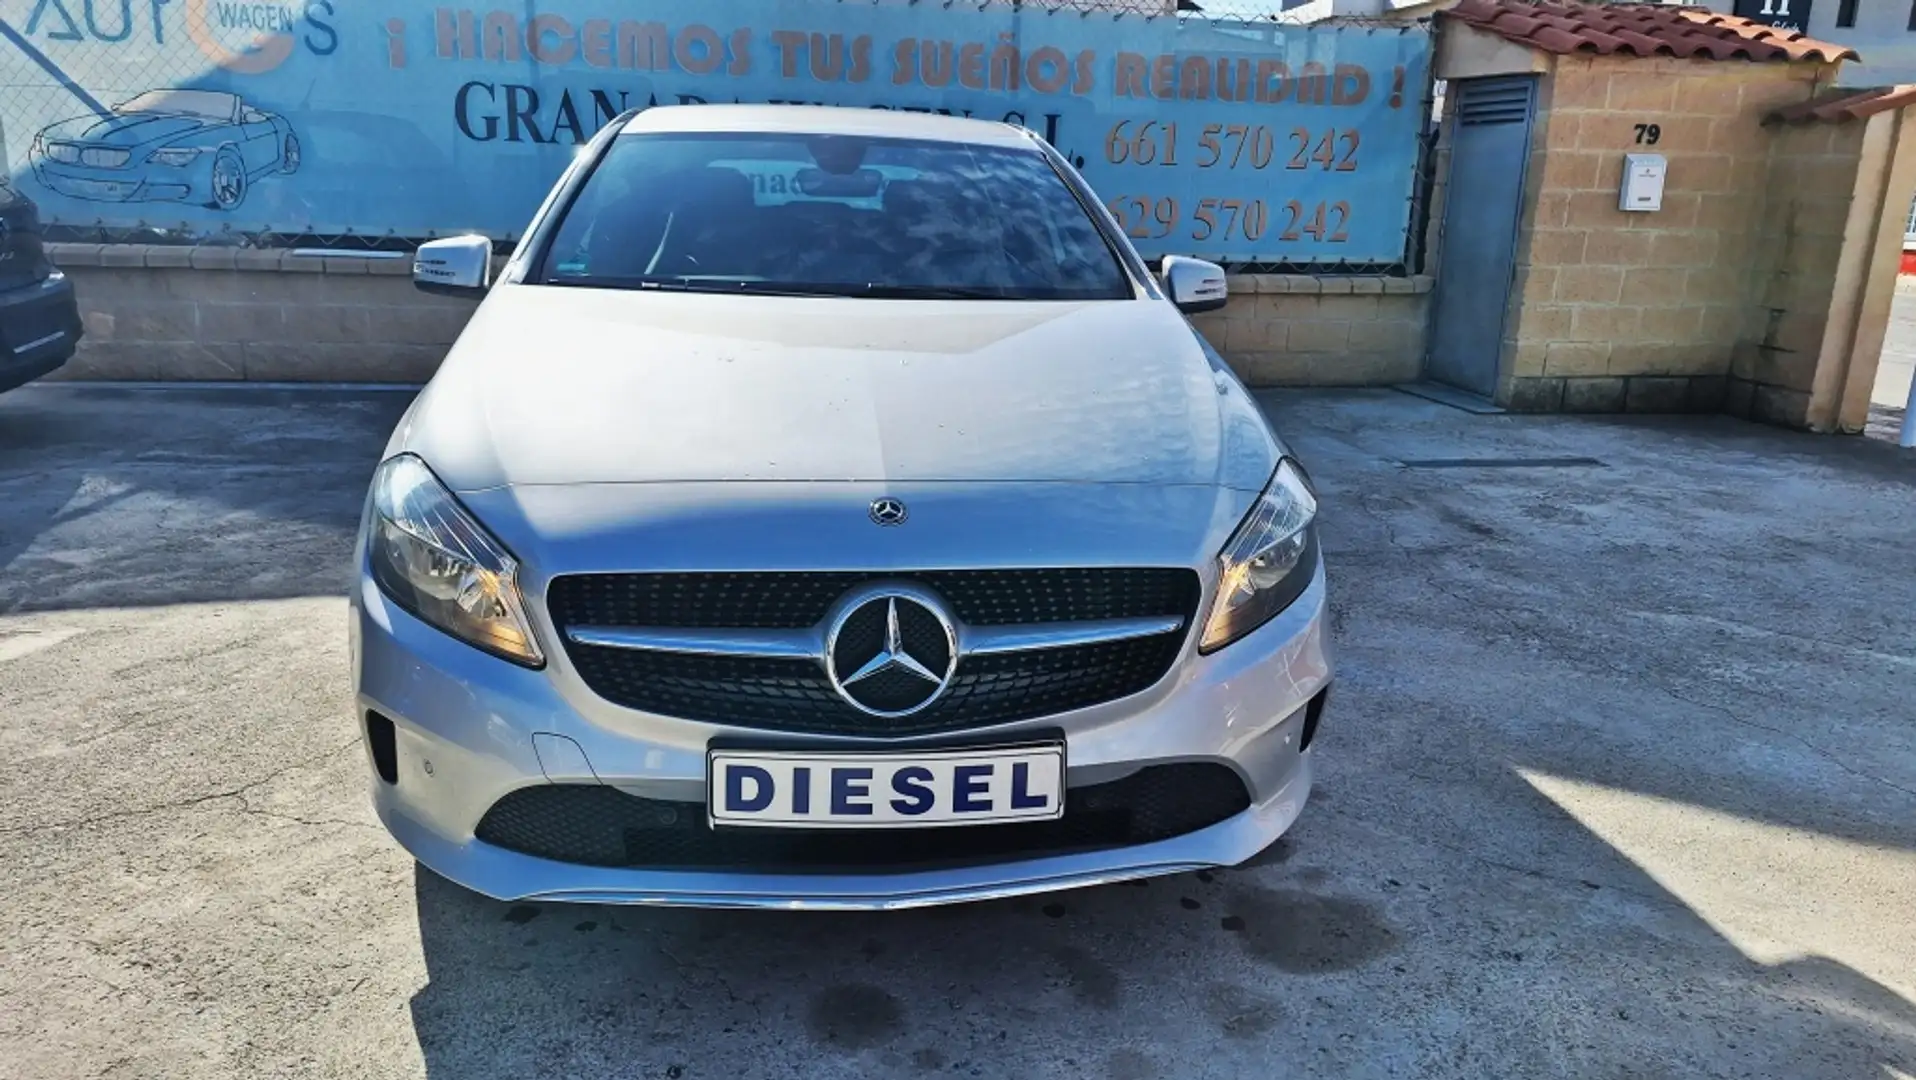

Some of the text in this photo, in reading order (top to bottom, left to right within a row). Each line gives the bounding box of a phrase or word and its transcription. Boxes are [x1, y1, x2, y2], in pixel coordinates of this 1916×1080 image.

[217, 2, 294, 32] WAGEN
[435, 7, 752, 76] HACEMOS
[771, 29, 872, 83] TUS
[891, 32, 1095, 95] SUEÑOS
[1115, 51, 1371, 107] REALIDAD
[1105, 119, 1360, 172] 661 570 242
[1634, 123, 1661, 145] 79
[1192, 198, 1267, 241] 570
[1278, 200, 1350, 243] 242
[725, 762, 1048, 815] DIESEL
